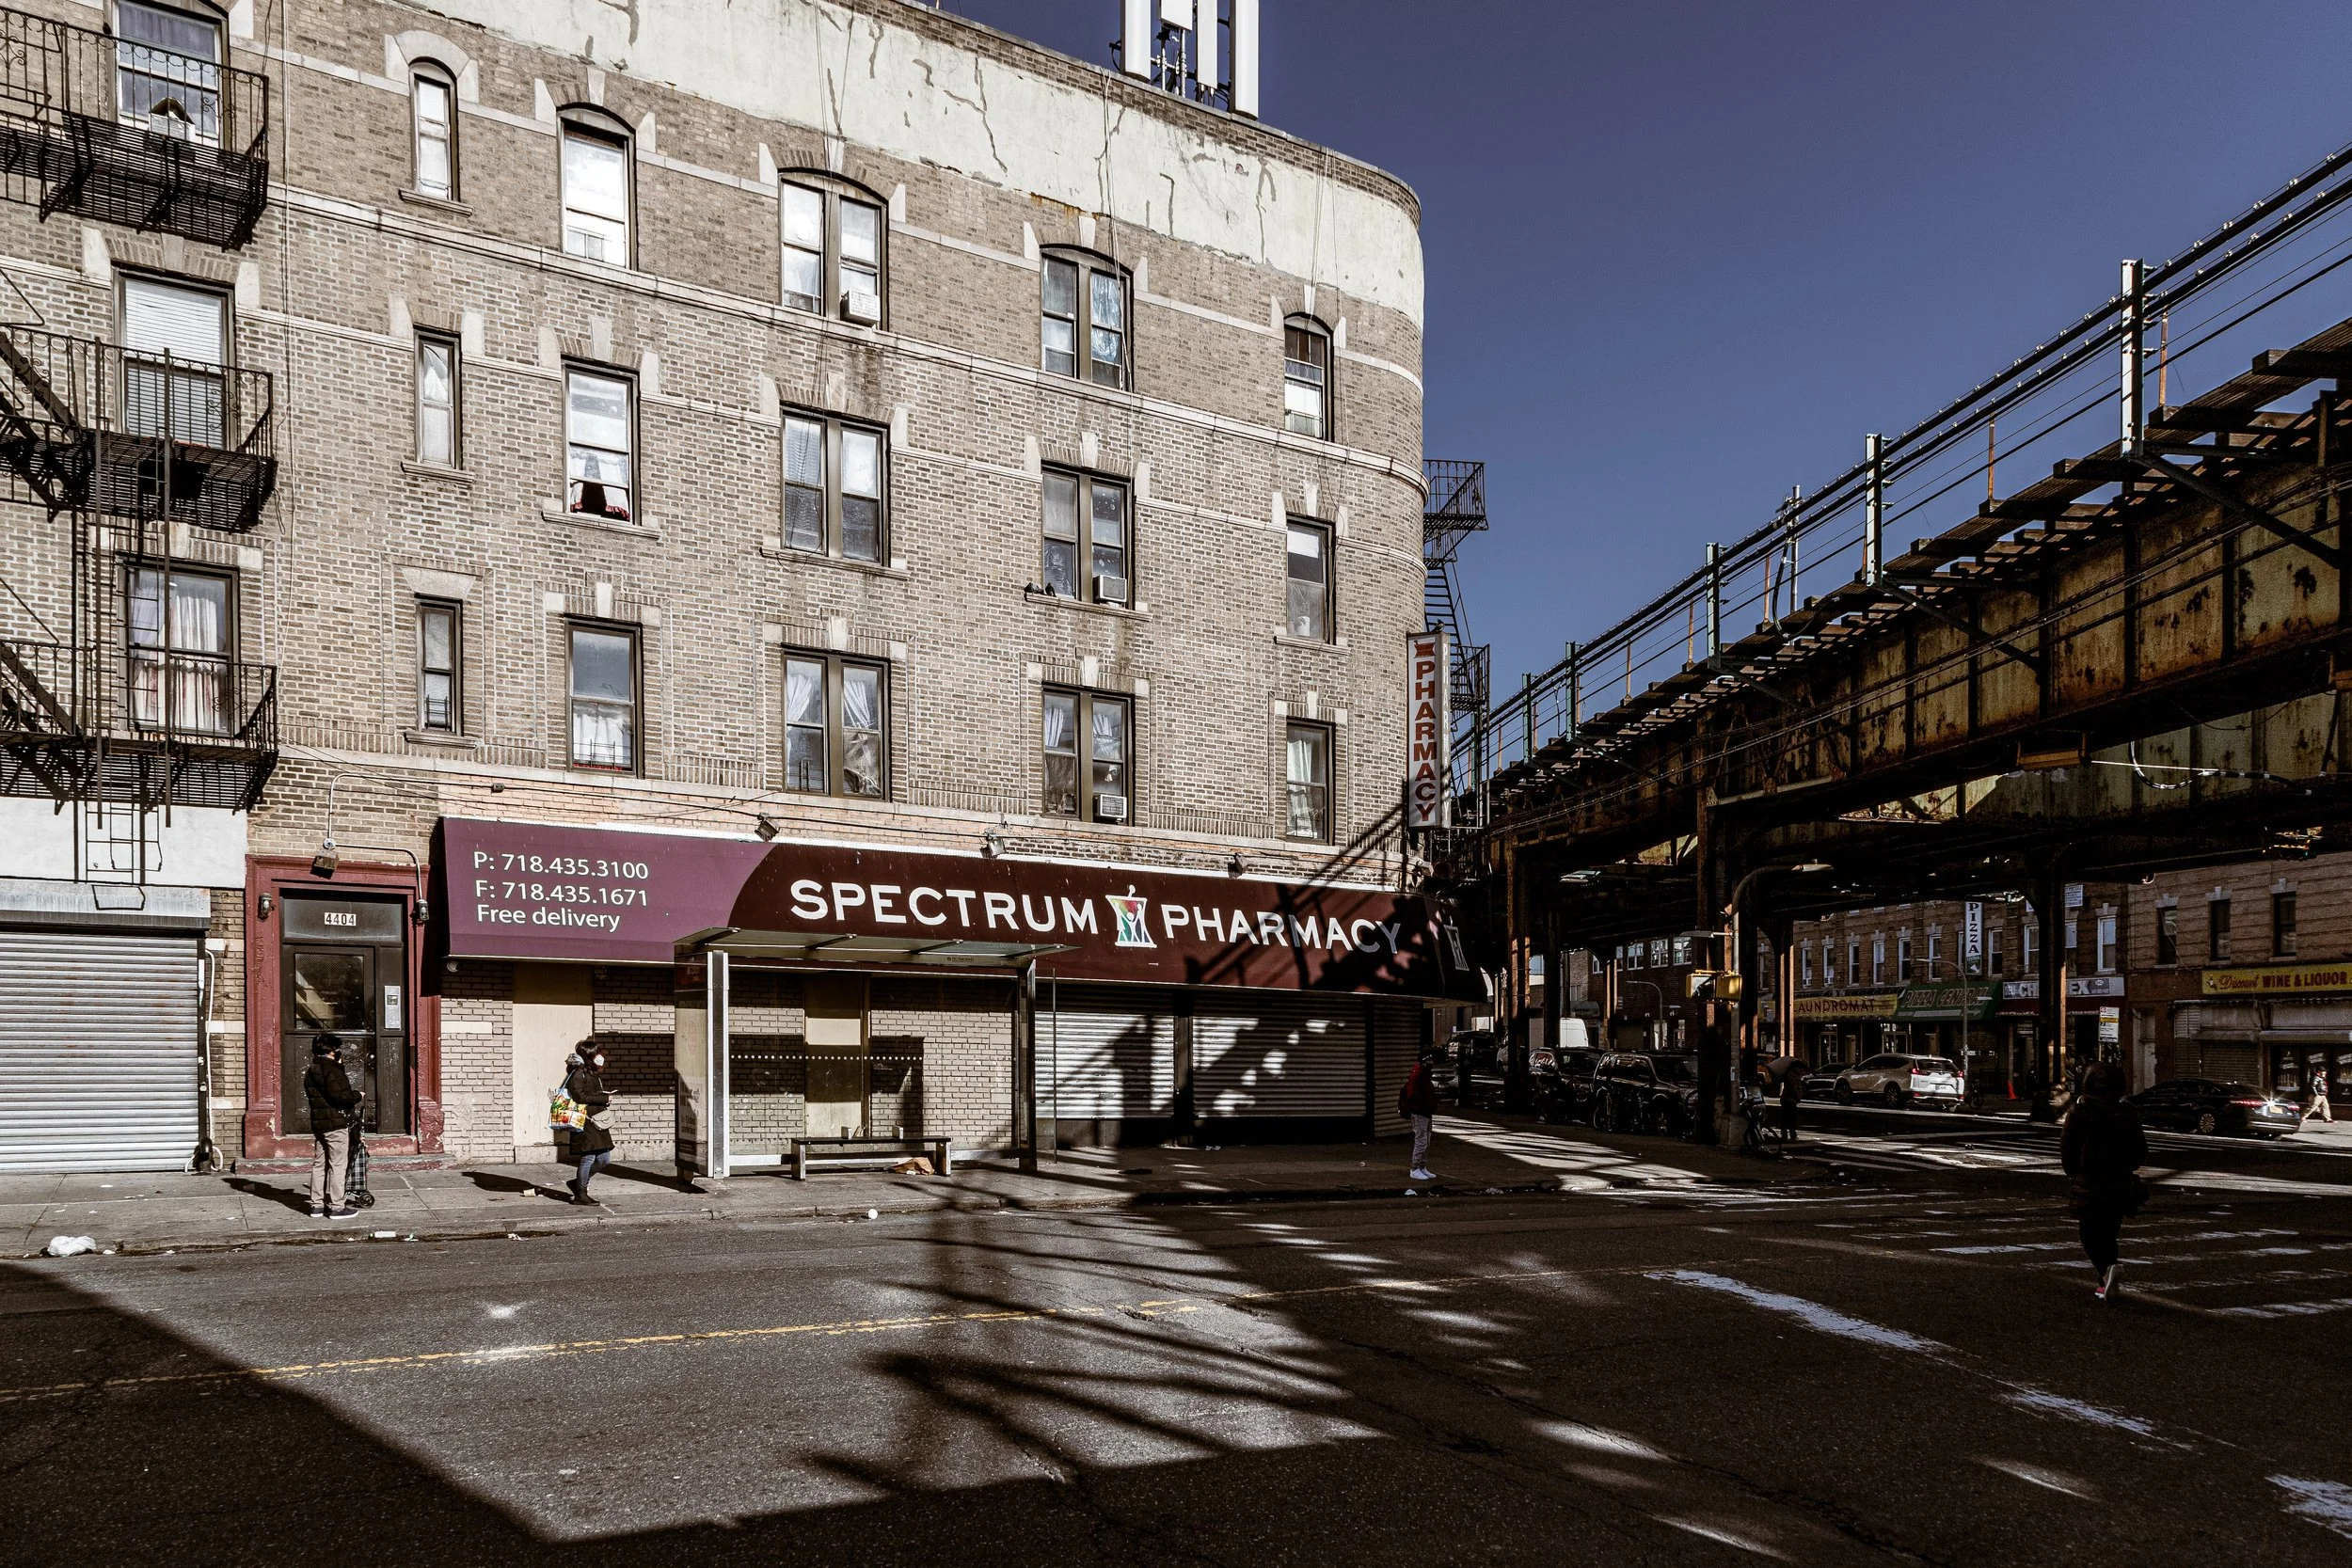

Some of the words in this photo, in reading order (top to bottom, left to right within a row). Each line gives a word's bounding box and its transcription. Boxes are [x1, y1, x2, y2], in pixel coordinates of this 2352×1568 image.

[1414, 660, 1438, 822] PHARMACY
[473, 851, 495, 870] P:
[501, 853, 649, 879] 718.435.3100
[475, 879, 496, 898] F:
[501, 881, 648, 906] 718.435.1671
[326, 912, 356, 926] 4404
[477, 904, 526, 924] Free
[532, 907, 621, 932] delivery
[790, 879, 1099, 934] SPECTRUM
[1161, 904, 1401, 954] PHARMACY
[1967, 902, 1980, 954] PIZZA
[2218, 974, 2259, 990] Discount
[2262, 974, 2291, 989] WINE
[2294, 974, 2302, 988] &
[2304, 972, 2348, 987] LIQUOR
[1900, 990, 1938, 1008] PIZZA
